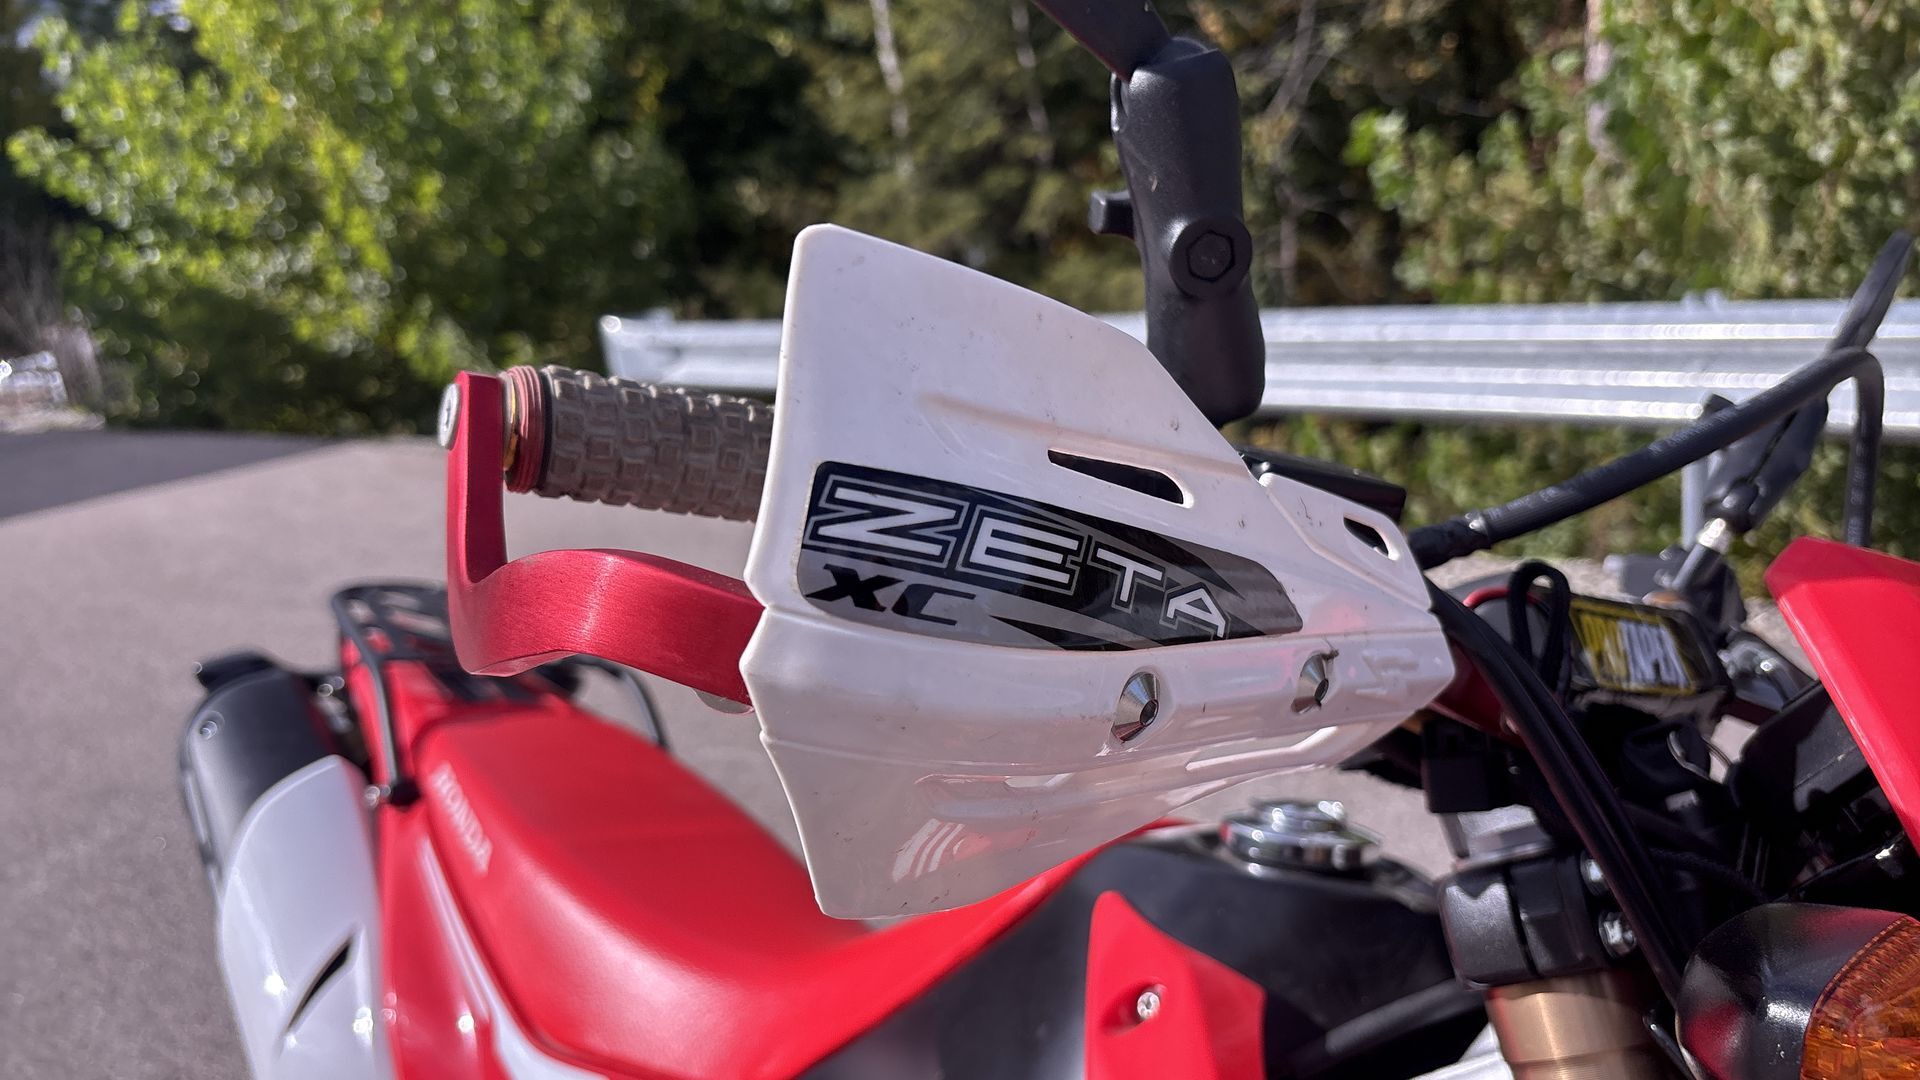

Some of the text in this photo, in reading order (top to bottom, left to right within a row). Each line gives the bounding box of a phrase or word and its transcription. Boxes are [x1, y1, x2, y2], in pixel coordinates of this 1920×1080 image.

[804, 475, 1230, 639] ZETA
[806, 564, 976, 627] XC
[428, 760, 493, 875] HONDA
